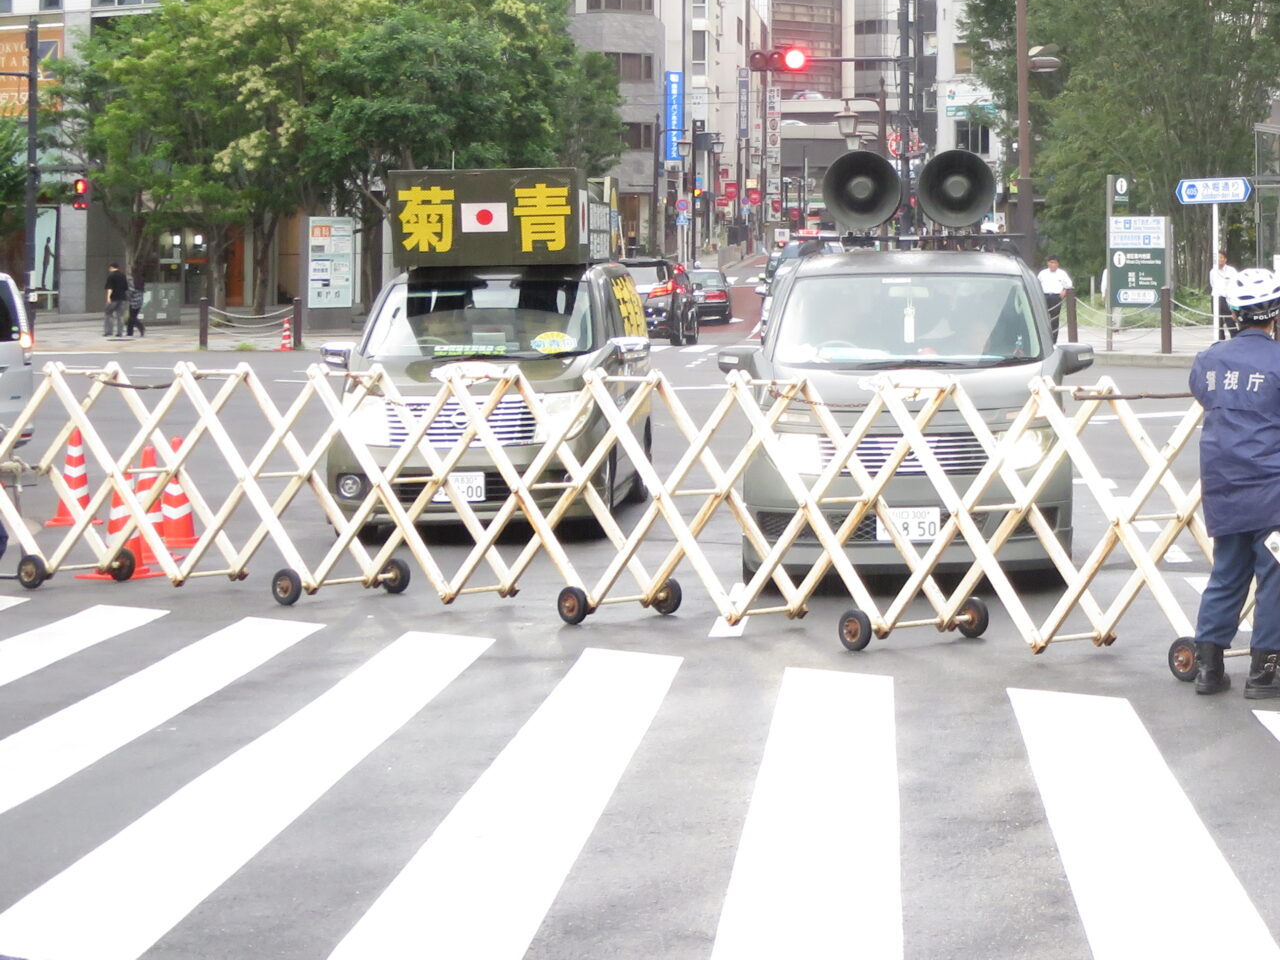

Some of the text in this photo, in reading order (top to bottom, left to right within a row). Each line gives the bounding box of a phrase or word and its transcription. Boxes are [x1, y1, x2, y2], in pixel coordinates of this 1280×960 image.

[398, 186, 455, 253] 菊
[513, 183, 572, 253] 青
[1253, 309, 1280, 321] POLICE
[1206, 370, 1265, 392] 警視庁
